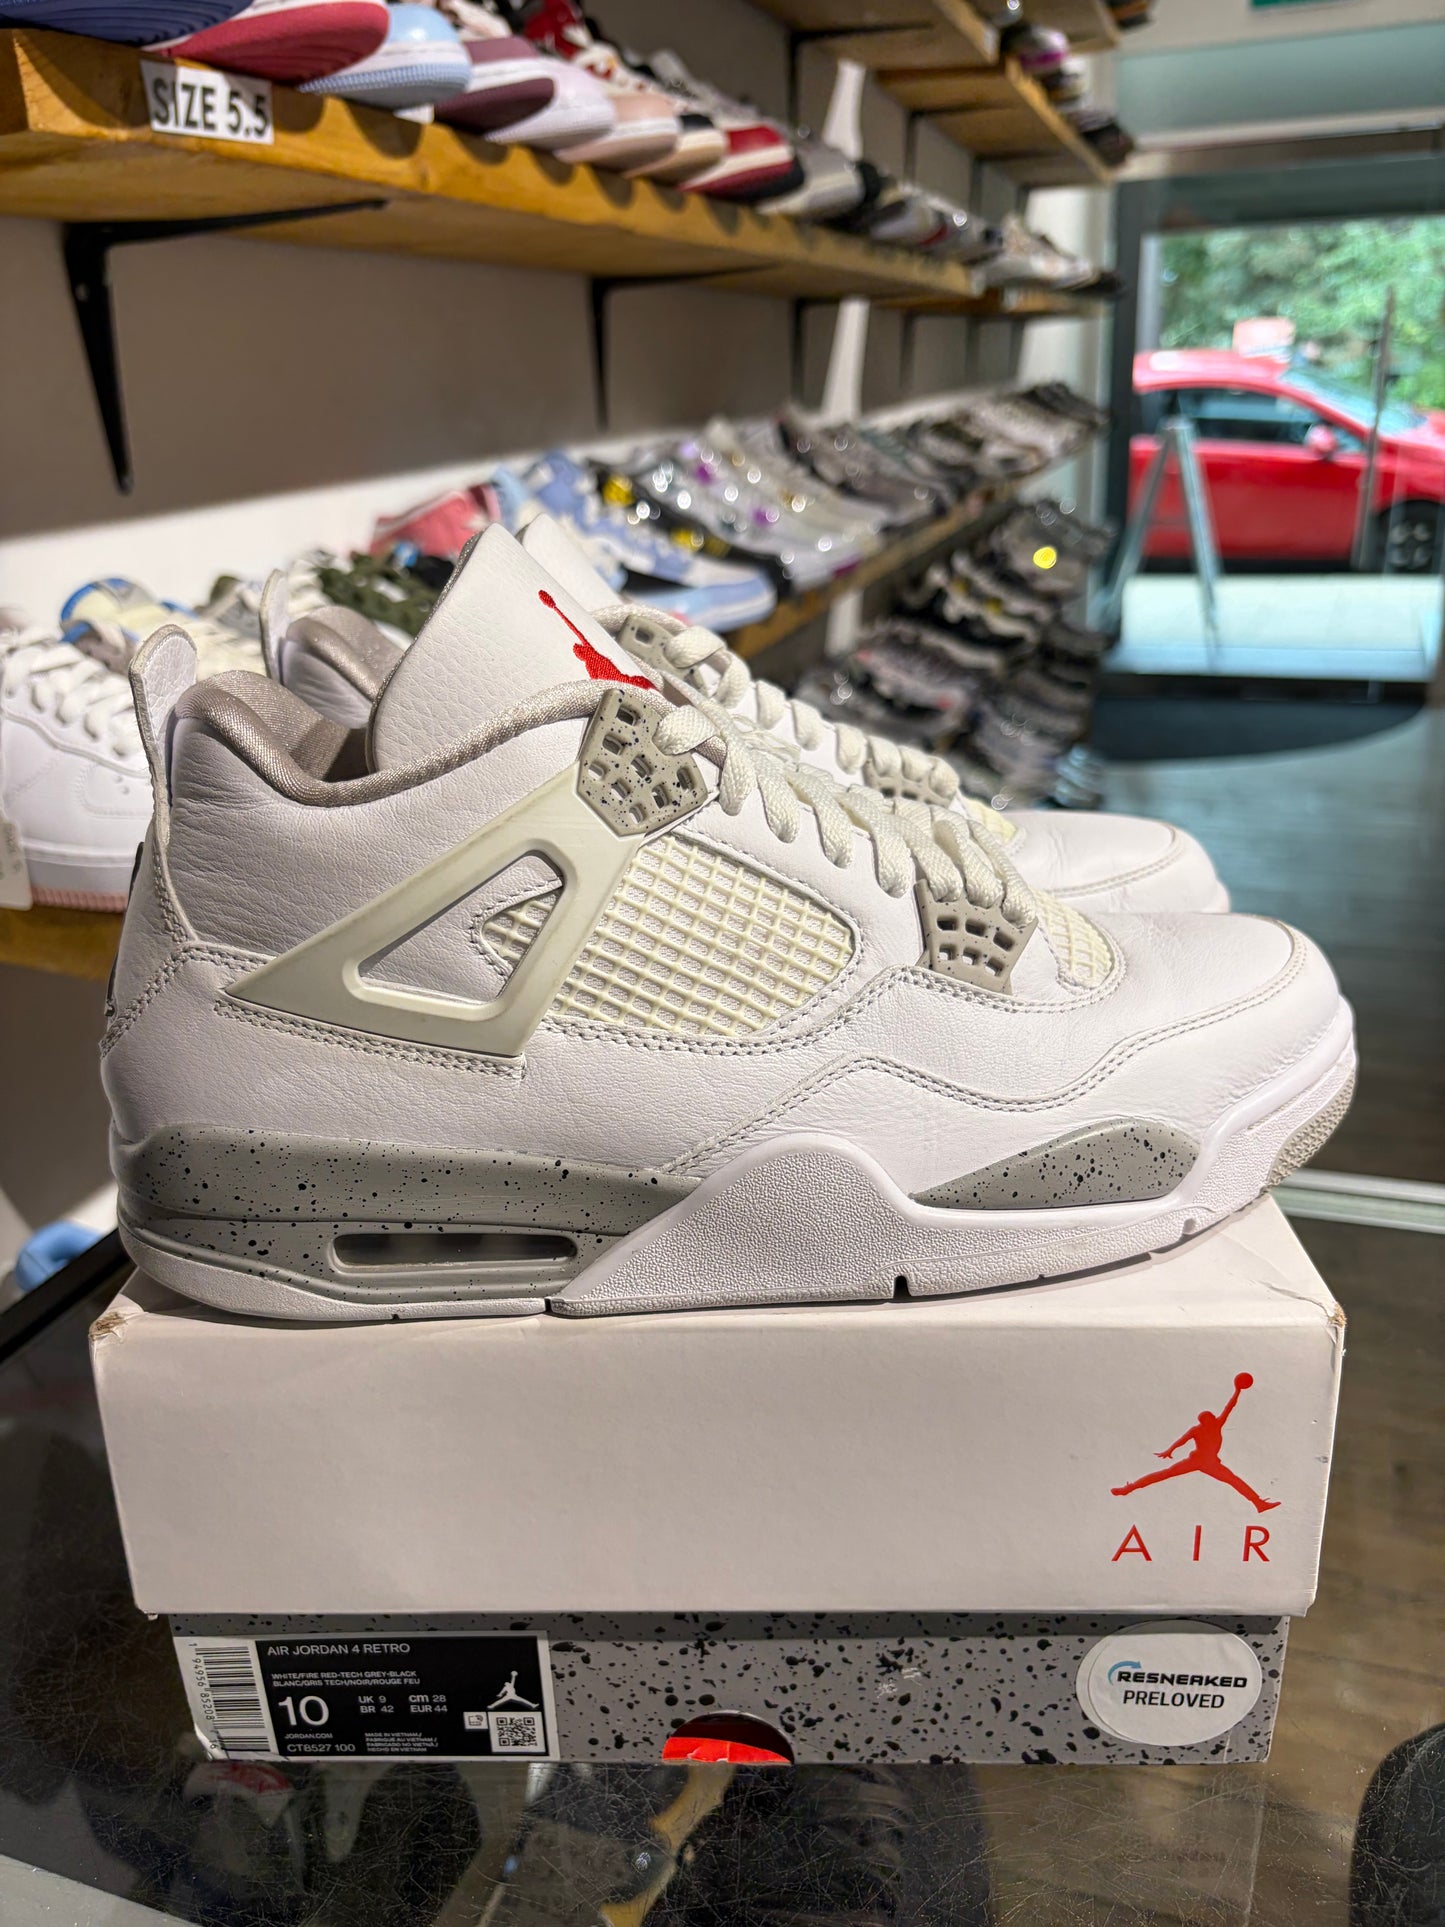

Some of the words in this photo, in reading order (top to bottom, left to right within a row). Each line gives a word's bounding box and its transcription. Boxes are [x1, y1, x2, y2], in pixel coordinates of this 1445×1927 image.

[153, 78, 216, 131] SIZE
[228, 89, 270, 138] 5.5
[1111, 1524, 1271, 1562] AIR
[267, 1645, 290, 1656] AIR
[292, 1644, 349, 1656] JORDAN
[351, 1644, 360, 1654] 4
[363, 1643, 411, 1654] RETRO
[192, 1658, 207, 1687] 94956
[271, 1672, 320, 1680] WHITE/FIRE
[320, 1671, 364, 1679] RED-TECH
[364, 1670, 417, 1678] GREY-BLACK
[272, 1680, 323, 1688] BLANC/GRIS
[324, 1678, 402, 1687] TECH/NOIR/ROUGE
[403, 1677, 420, 1685] FEU
[1117, 1670, 1248, 1688] RESNEAKED
[358, 1695, 374, 1704] UK
[378, 1695, 387, 1704] 9
[408, 1694, 430, 1703] cm
[432, 1694, 447, 1703] 28
[1122, 1690, 1225, 1709] PRELOVED
[200, 1693, 215, 1721] 85208
[277, 1695, 329, 1727] 10
[360, 1706, 376, 1714] BR
[380, 1705, 395, 1713] 42
[410, 1705, 433, 1713] EUR
[433, 1704, 448, 1713] 44
[284, 1732, 334, 1740] JORDAN.COM
[286, 1743, 331, 1753] CT8527
[334, 1743, 356, 1752] 100
